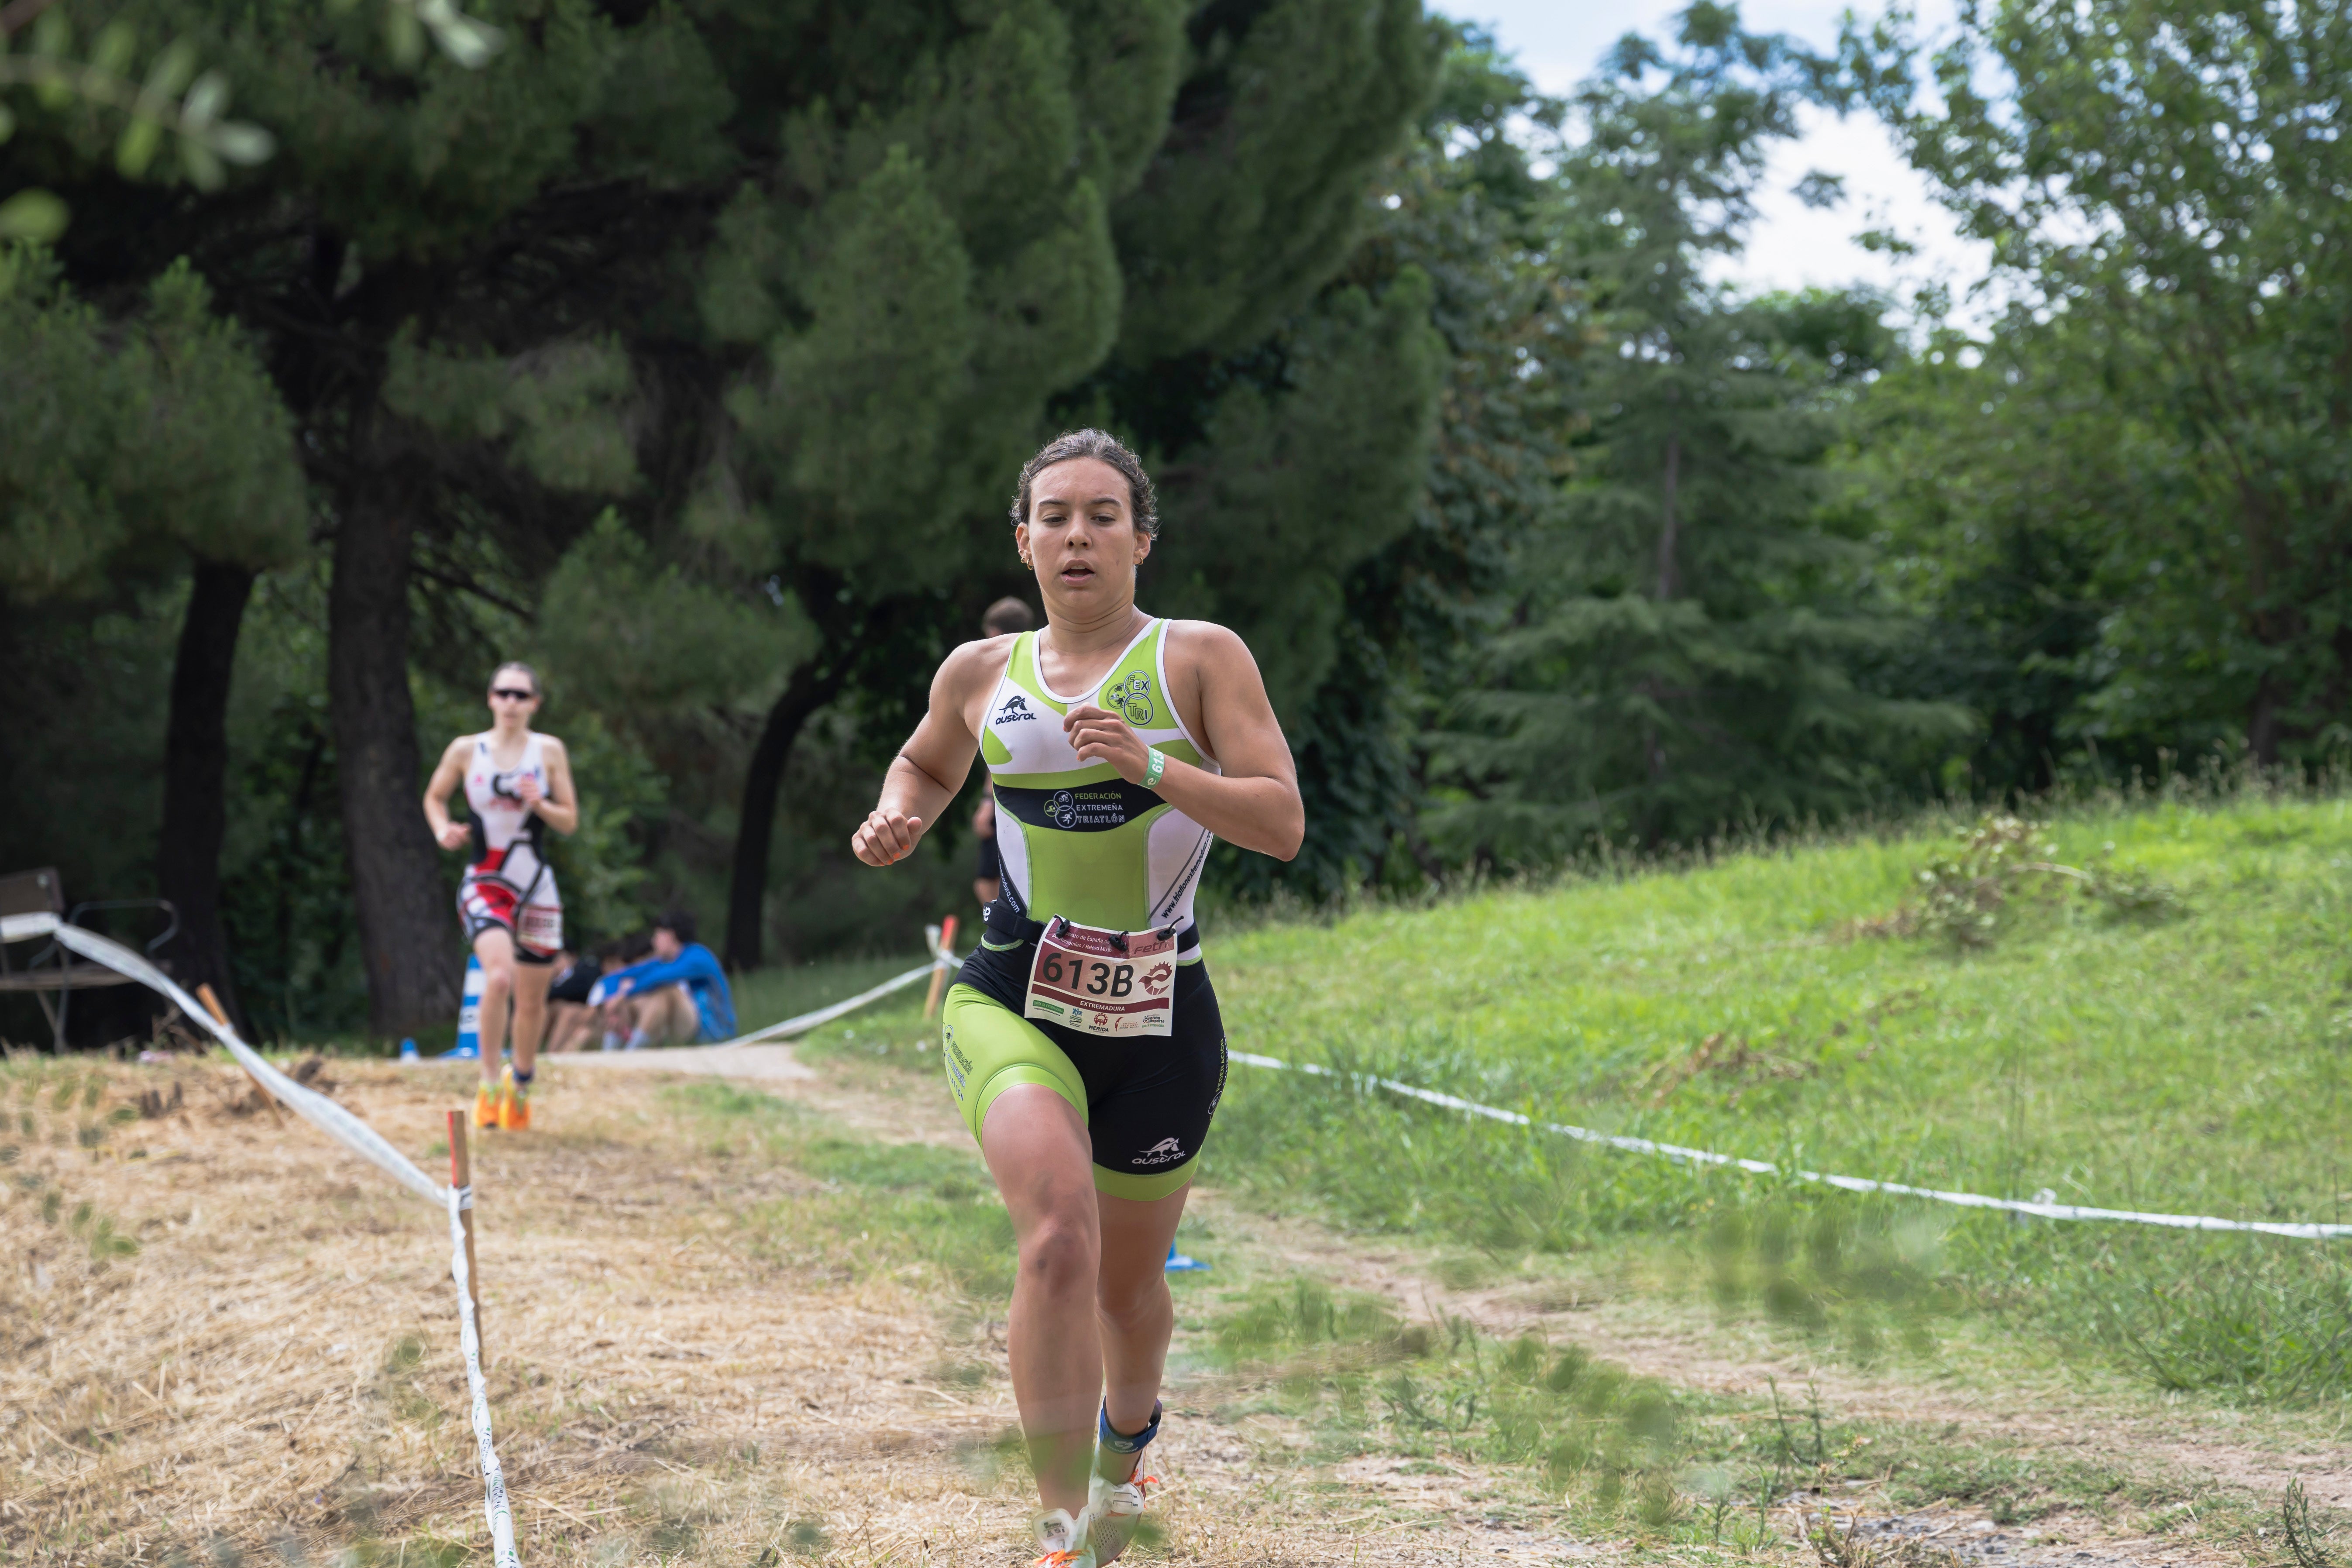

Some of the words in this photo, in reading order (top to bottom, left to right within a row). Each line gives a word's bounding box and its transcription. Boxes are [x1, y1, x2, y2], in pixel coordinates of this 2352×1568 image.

[1127, 675, 1148, 691] FEX
[996, 713, 1037, 725] austral
[1128, 703, 1148, 720] TRI
[1152, 750, 1164, 773] 613
[1075, 791, 1121, 800] FEDERACIÓN
[1076, 803, 1123, 811] EXTREMEÑA
[1077, 812, 1125, 823] TRIATLÓN
[1161, 831, 1211, 918] www.triatlonextremadura.co
[1043, 952, 1134, 997] 613B
[1080, 1001, 1125, 1011] EXTREMADURA
[1131, 1150, 1186, 1165] austral
